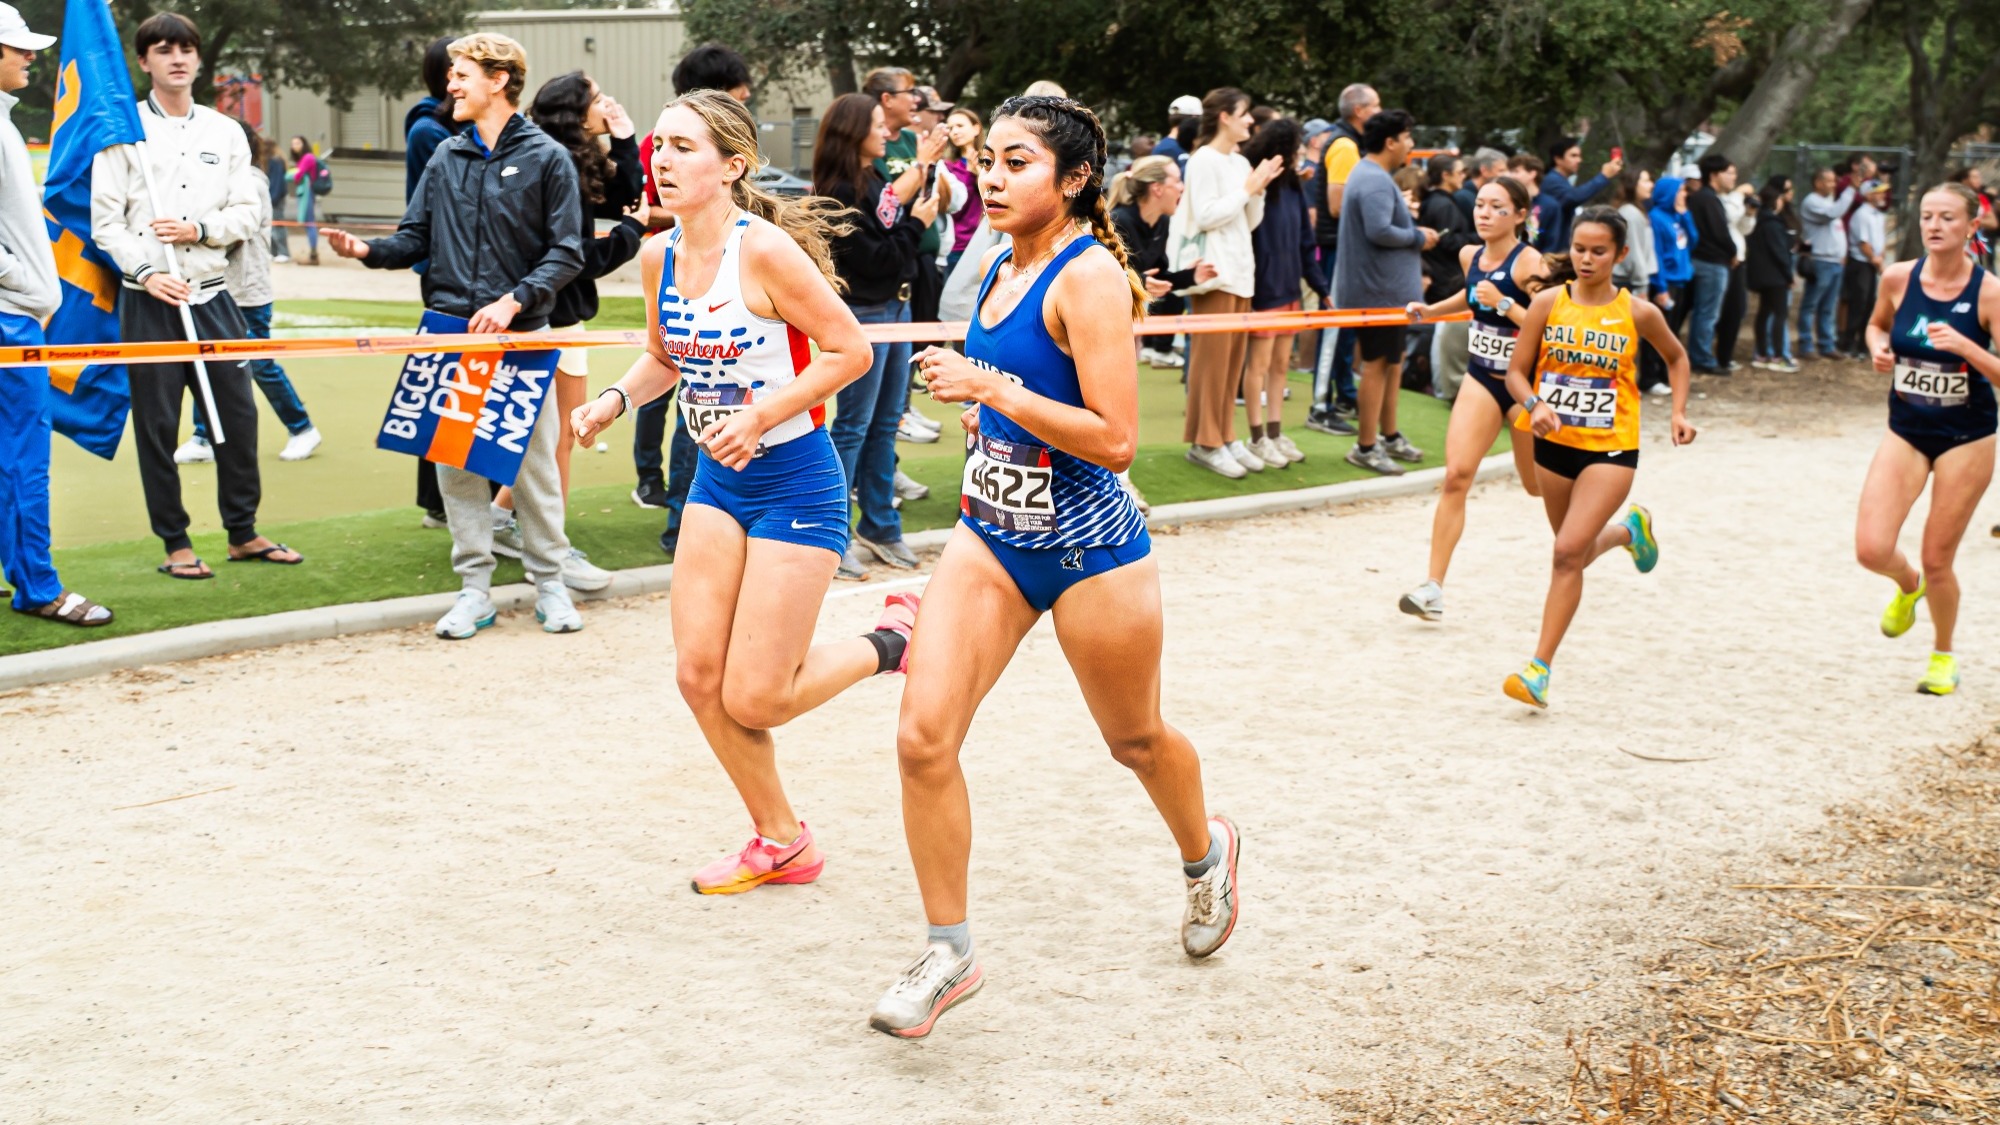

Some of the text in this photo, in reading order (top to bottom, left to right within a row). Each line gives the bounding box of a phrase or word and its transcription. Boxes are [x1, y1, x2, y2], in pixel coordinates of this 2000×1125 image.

[1544, 325, 1628, 353] CAL POLY
[1547, 346, 1619, 371] POMONA
[1902, 370, 1966, 395] 4602
[472, 359, 519, 441] IN THE
[496, 370, 550, 454] NCAA
[1546, 388, 1615, 413] 4432
[971, 460, 1050, 509] 4622
